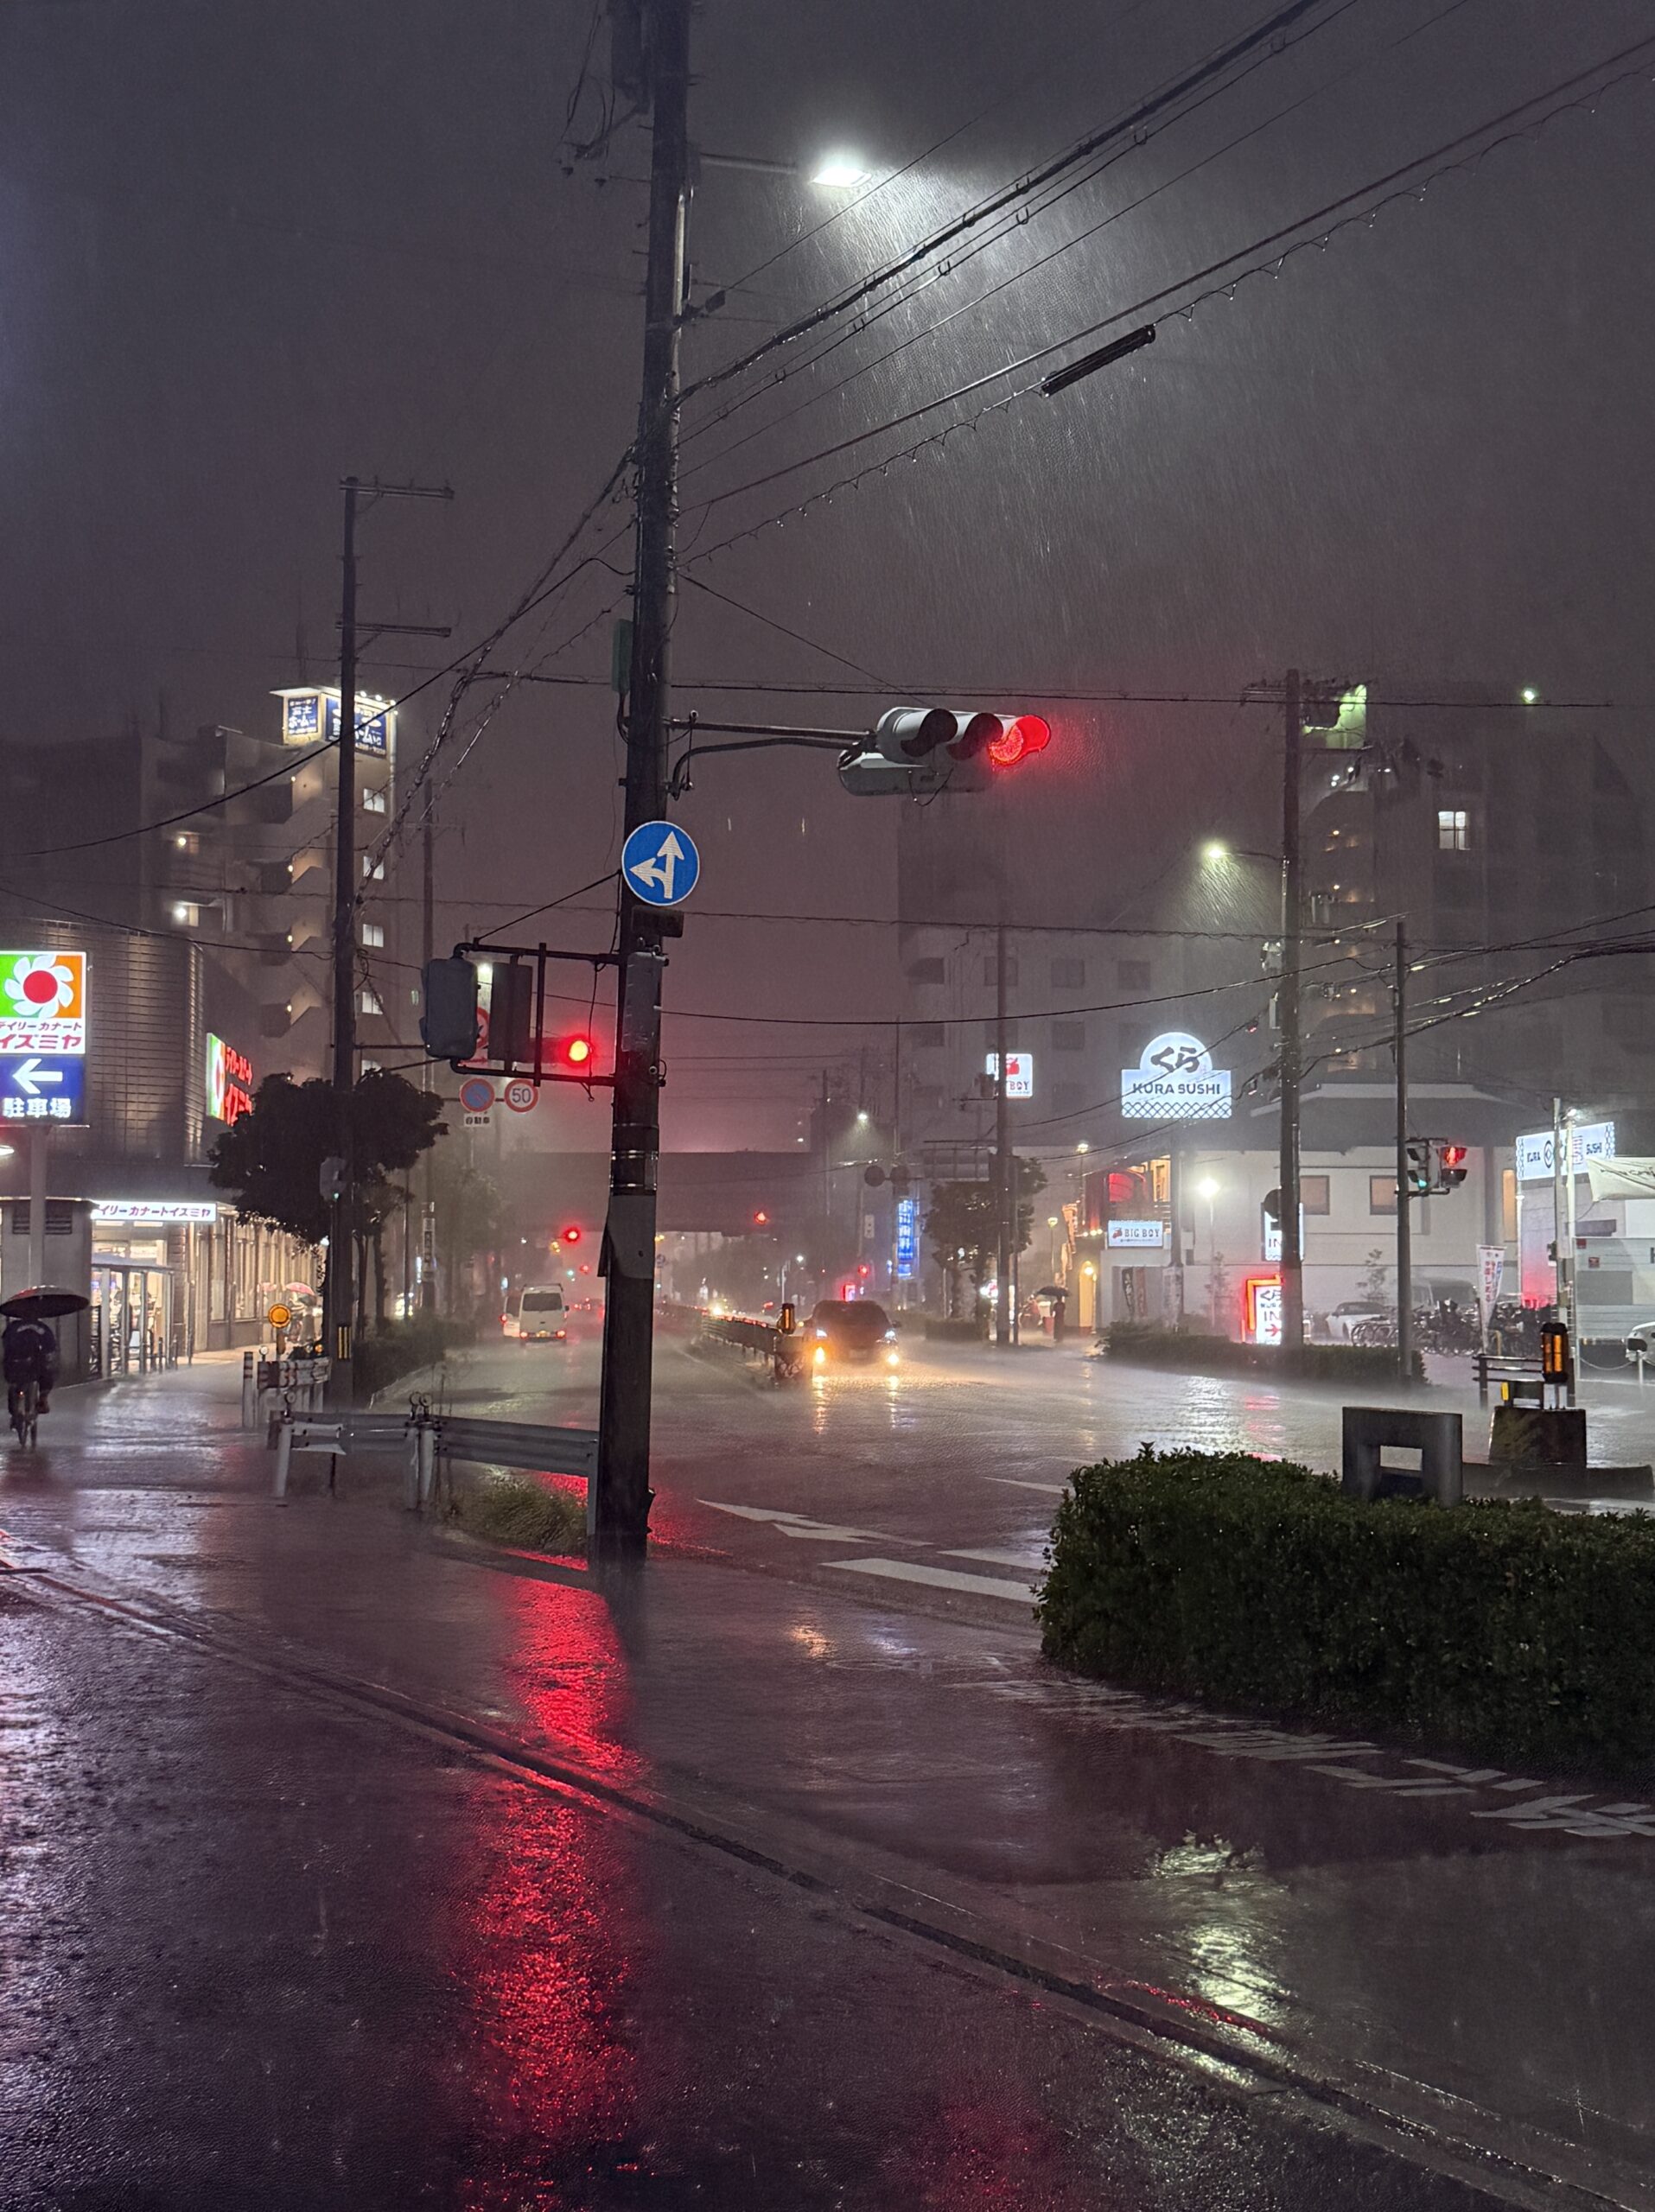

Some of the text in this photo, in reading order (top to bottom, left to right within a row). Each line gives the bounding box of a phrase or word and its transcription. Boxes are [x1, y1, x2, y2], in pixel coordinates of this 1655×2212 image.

[0, 1033, 82, 1050] イズミヤ
[1150, 1046, 1200, 1073] くら
[1009, 1081, 1029, 1090] BOY
[1132, 1083, 1220, 1095] KURA SUSHI
[512, 1088, 531, 1103] 50
[3, 1097, 71, 1118] 駐車場
[1124, 1229, 1160, 1237] BIG BOY
